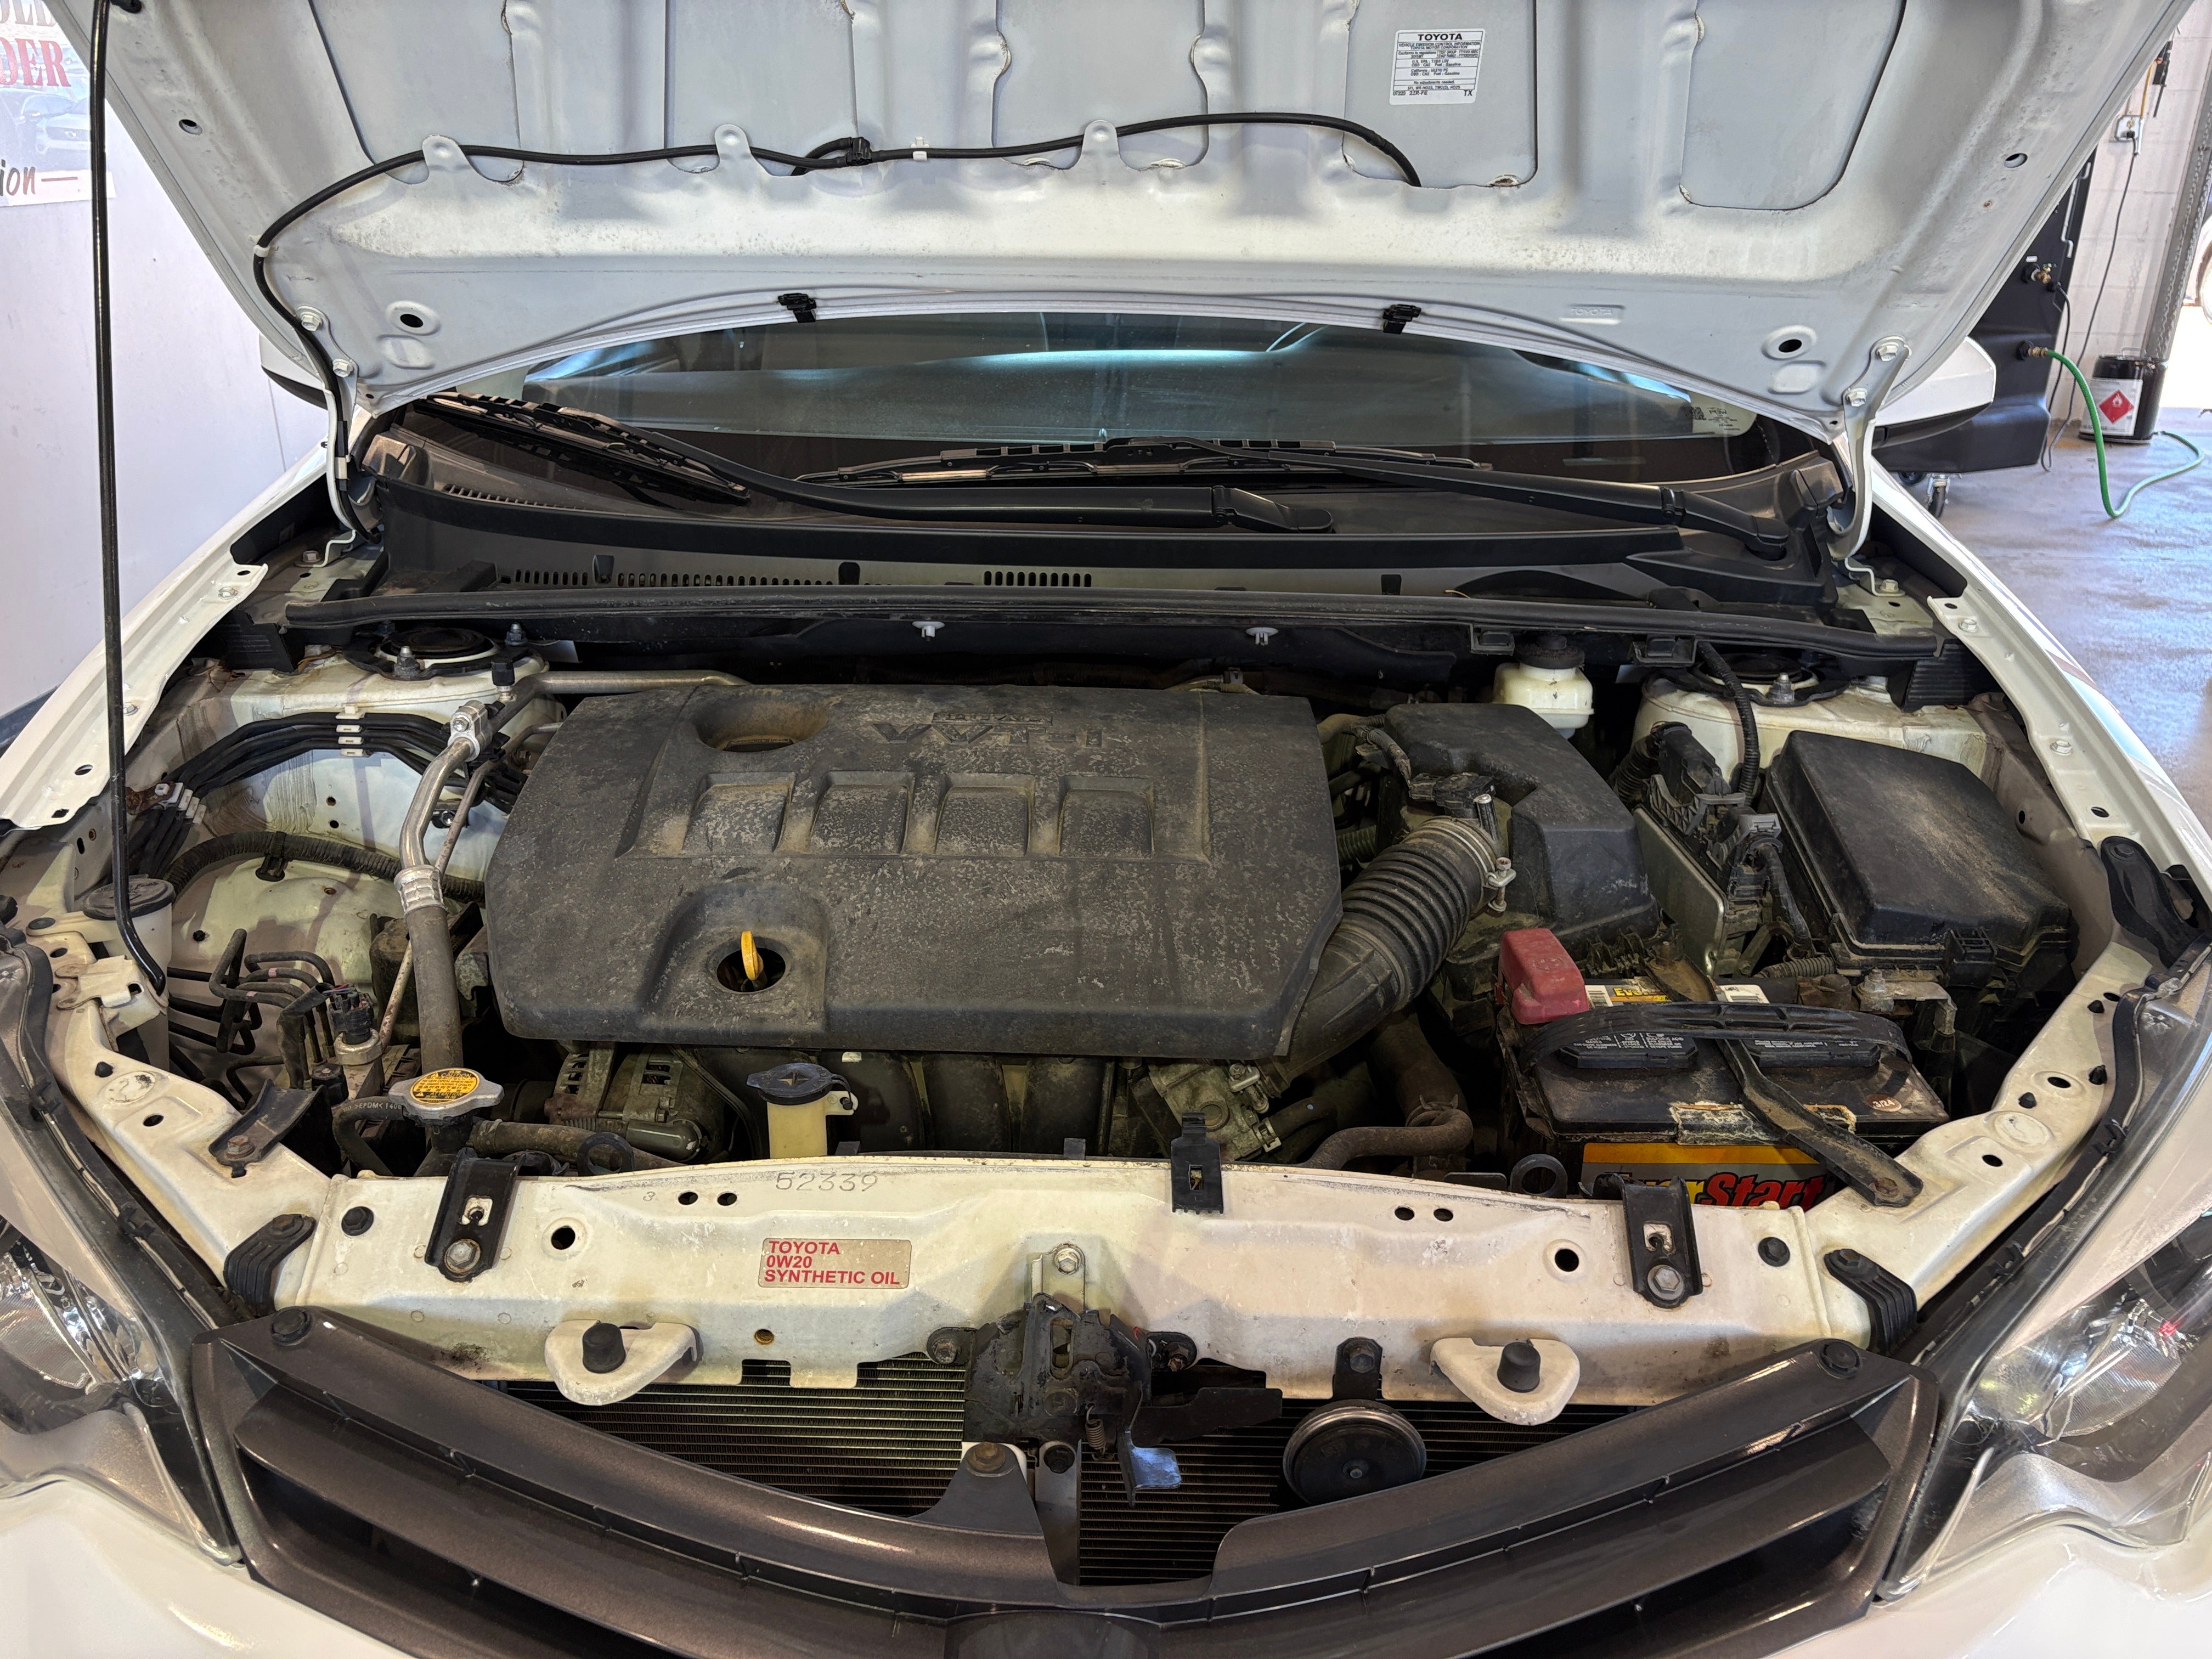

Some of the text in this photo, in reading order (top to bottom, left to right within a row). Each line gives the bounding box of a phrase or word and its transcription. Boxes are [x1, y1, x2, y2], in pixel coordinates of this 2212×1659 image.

[1872, 1099, 1895, 1108] 3/24
[775, 1171, 878, 1192] 52339
[642, 1191, 656, 1201] 3
[769, 1240, 840, 1255] TOYOTA
[766, 1255, 812, 1268] 0W20
[764, 1269, 900, 1285] SYNTHETIC OIL
